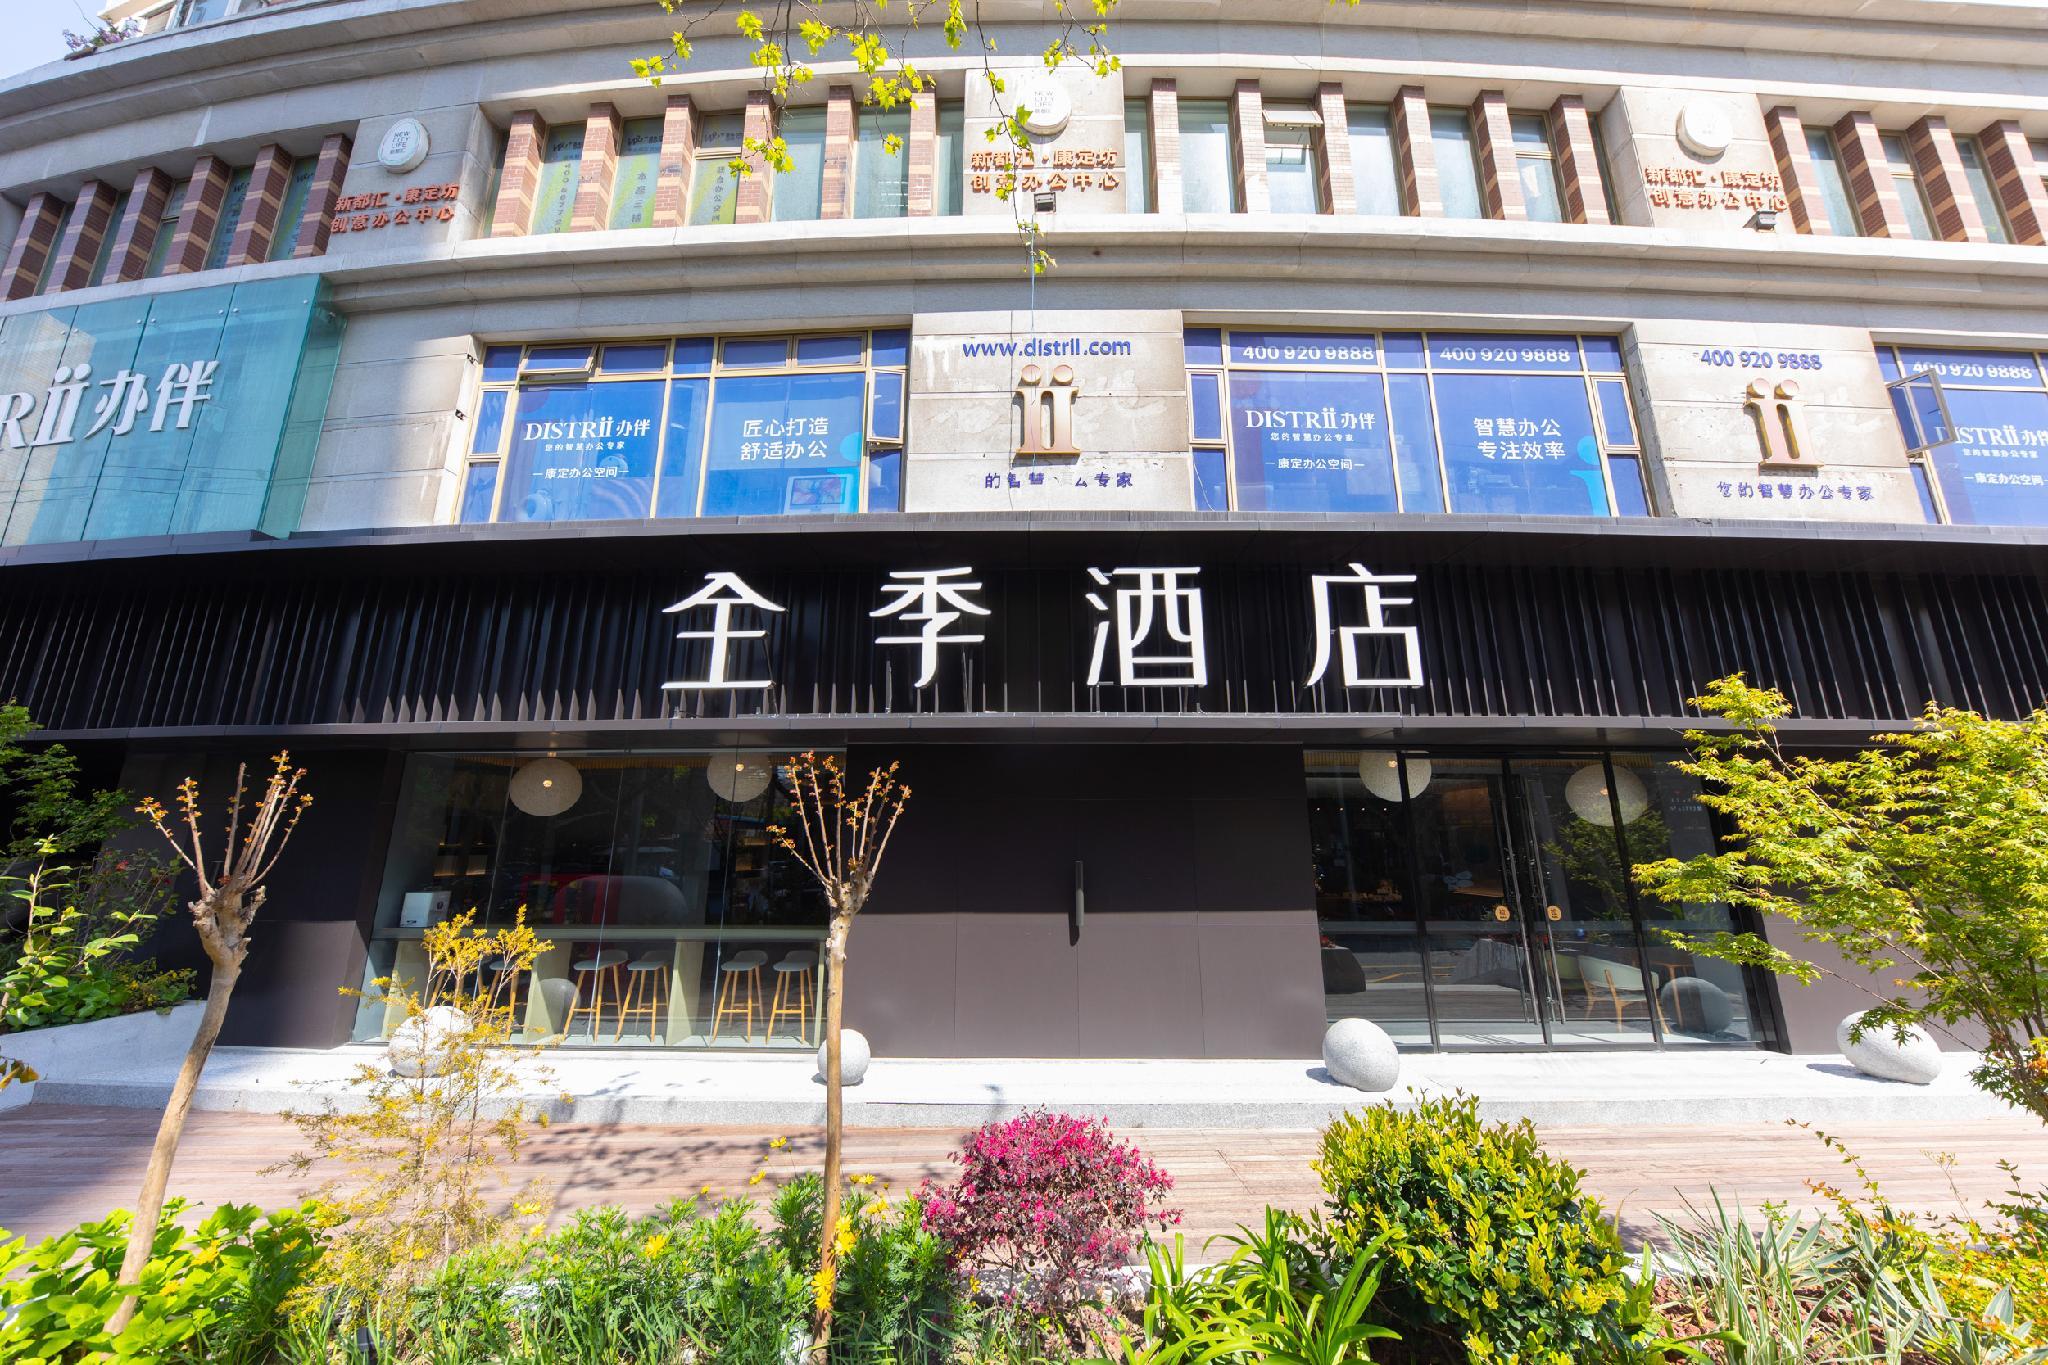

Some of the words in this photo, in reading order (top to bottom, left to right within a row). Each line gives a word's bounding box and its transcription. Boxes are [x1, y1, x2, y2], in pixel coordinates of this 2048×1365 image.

[330, 203, 455, 234] 创意办公中心
[1243, 346, 1279, 360] 400
[1284, 346, 1320, 360] 920
[1324, 346, 1374, 360] 9888
[1440, 348, 1476, 361] 400
[1481, 348, 1517, 362] 920
[1521, 349, 1570, 363] 9888
[1701, 350, 1734, 367] 400
[1740, 352, 1773, 369] 920
[1777, 353, 1823, 370] 9888
[1951, 363, 1983, 378] 920
[1987, 365, 2033, 379] 9888
[84, 360, 220, 440] 办伴
[616, 418, 651, 437] 办伴
[743, 416, 829, 438] 匠心打造
[1340, 412, 1376, 430] 办伴
[1474, 418, 1562, 437] 智慧办公
[545, 441, 625, 452] 您的智慧办公专家
[1270, 432, 1354, 443] 您的智慧办公专家
[740, 440, 828, 461] 舒适办公
[1477, 440, 1566, 460] 专注效率
[544, 466, 618, 480] 康定办公空间
[1278, 458, 1353, 471] 康定办公空间
[661, 563, 1424, 690] 全季酒店
